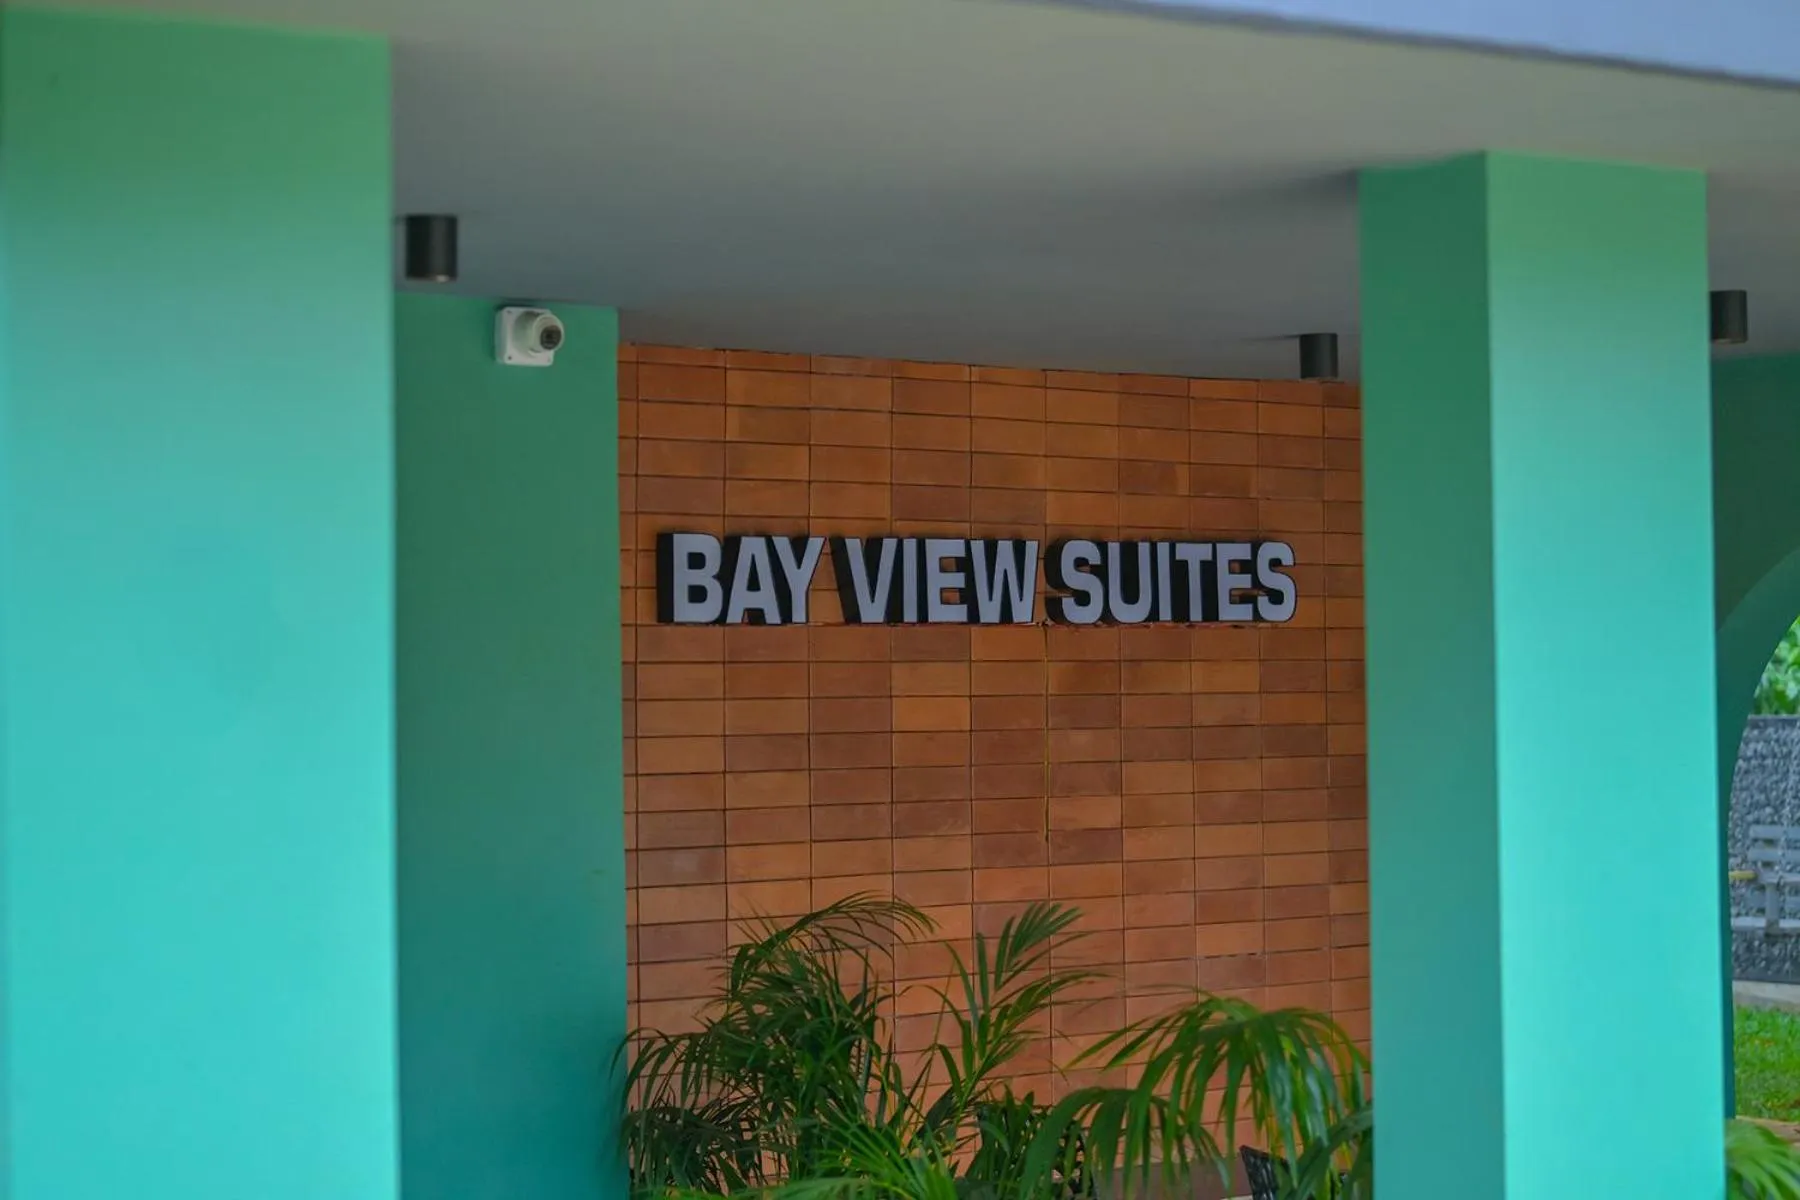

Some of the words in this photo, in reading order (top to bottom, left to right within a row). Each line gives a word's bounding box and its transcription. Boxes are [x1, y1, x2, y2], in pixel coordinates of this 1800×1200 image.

[672, 532, 825, 624] BAY
[845, 537, 1039, 624] VIEW
[1060, 539, 1296, 623] SUITES
